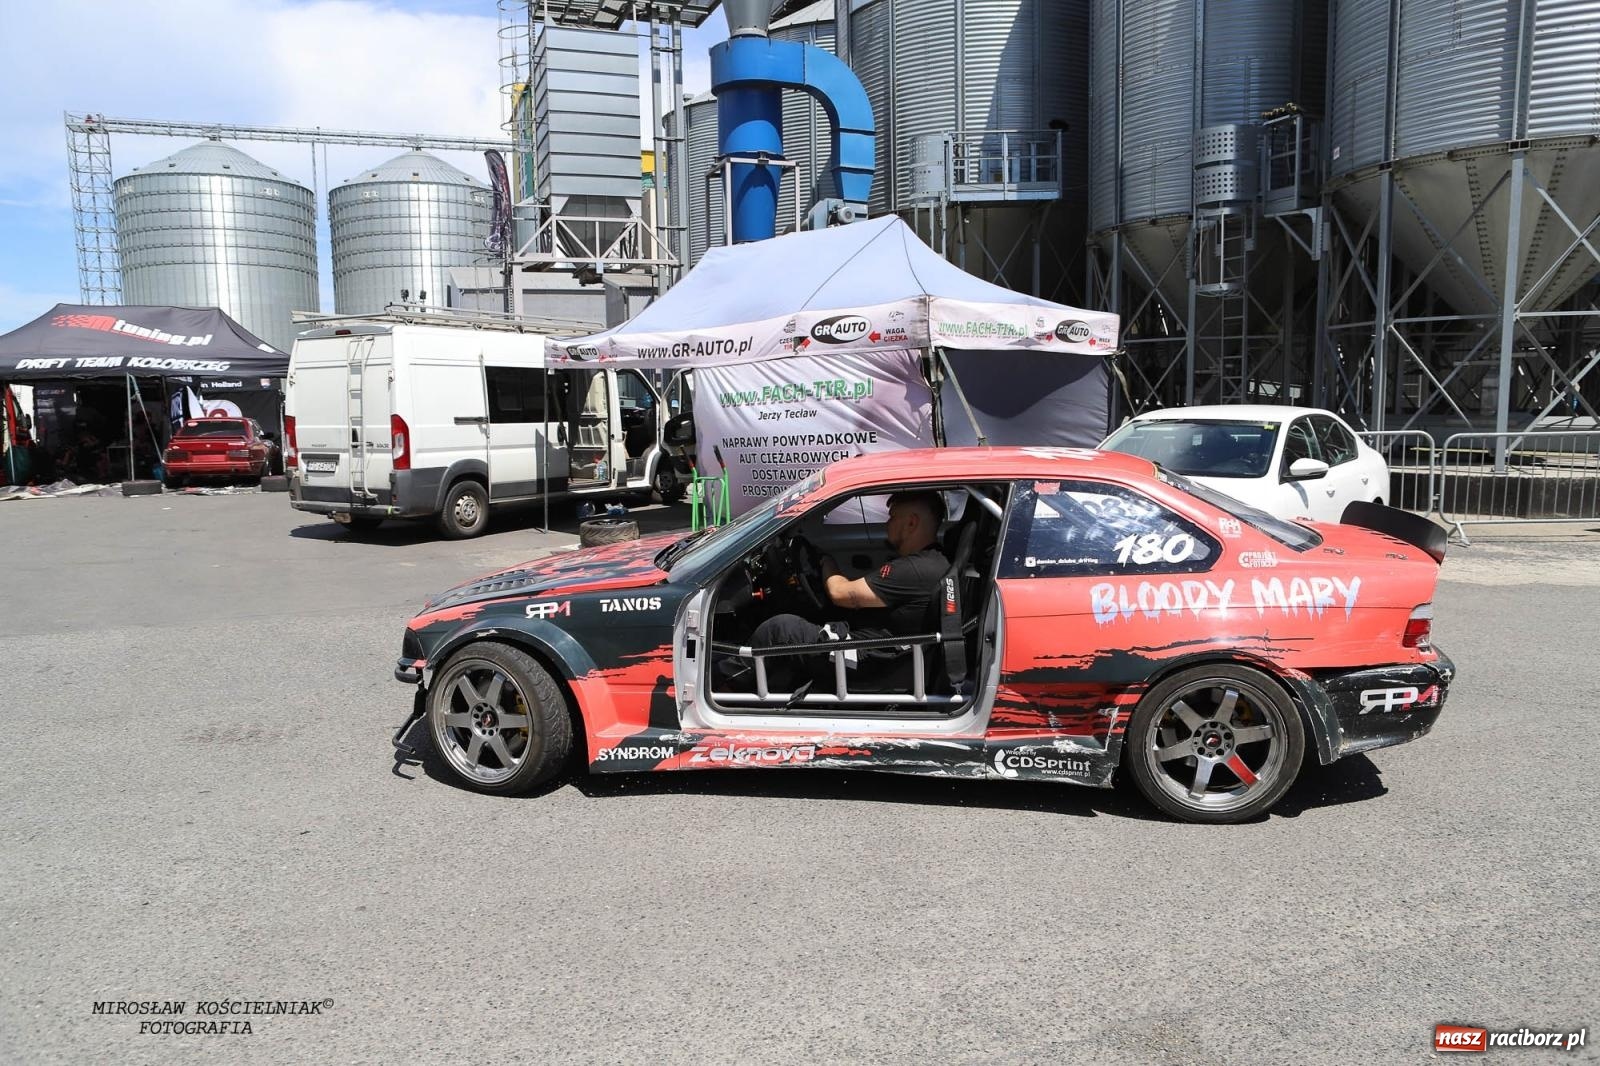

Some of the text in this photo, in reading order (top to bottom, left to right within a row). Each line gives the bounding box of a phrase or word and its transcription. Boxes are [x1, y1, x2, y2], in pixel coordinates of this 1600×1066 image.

[814, 321, 867, 336] GR AUTO
[885, 327, 905, 335] WAGA
[1069, 326, 1090, 337] AUTO
[579, 347, 597, 356] AUTO
[637, 336, 753, 359] www.GR-AUTO.pl
[15, 358, 72, 370] DRIFT
[75, 356, 124, 369] TEAM
[719, 378, 874, 408] www.FACH-TIR.pl
[758, 408, 817, 421] Jerzy Tecław
[722, 431, 878, 448] NAPRAWY POWYPADKOWE
[739, 450, 849, 467] AUT CIĘŻAROWYCH
[752, 469, 820, 481] DOSTAWCZ
[1112, 532, 1195, 567] 180
[600, 597, 661, 612] TANOS
[1089, 576, 1362, 628] BLOODY MARY
[597, 746, 674, 761] SYNDROM
[1006, 756, 1091, 772] CDSprint
